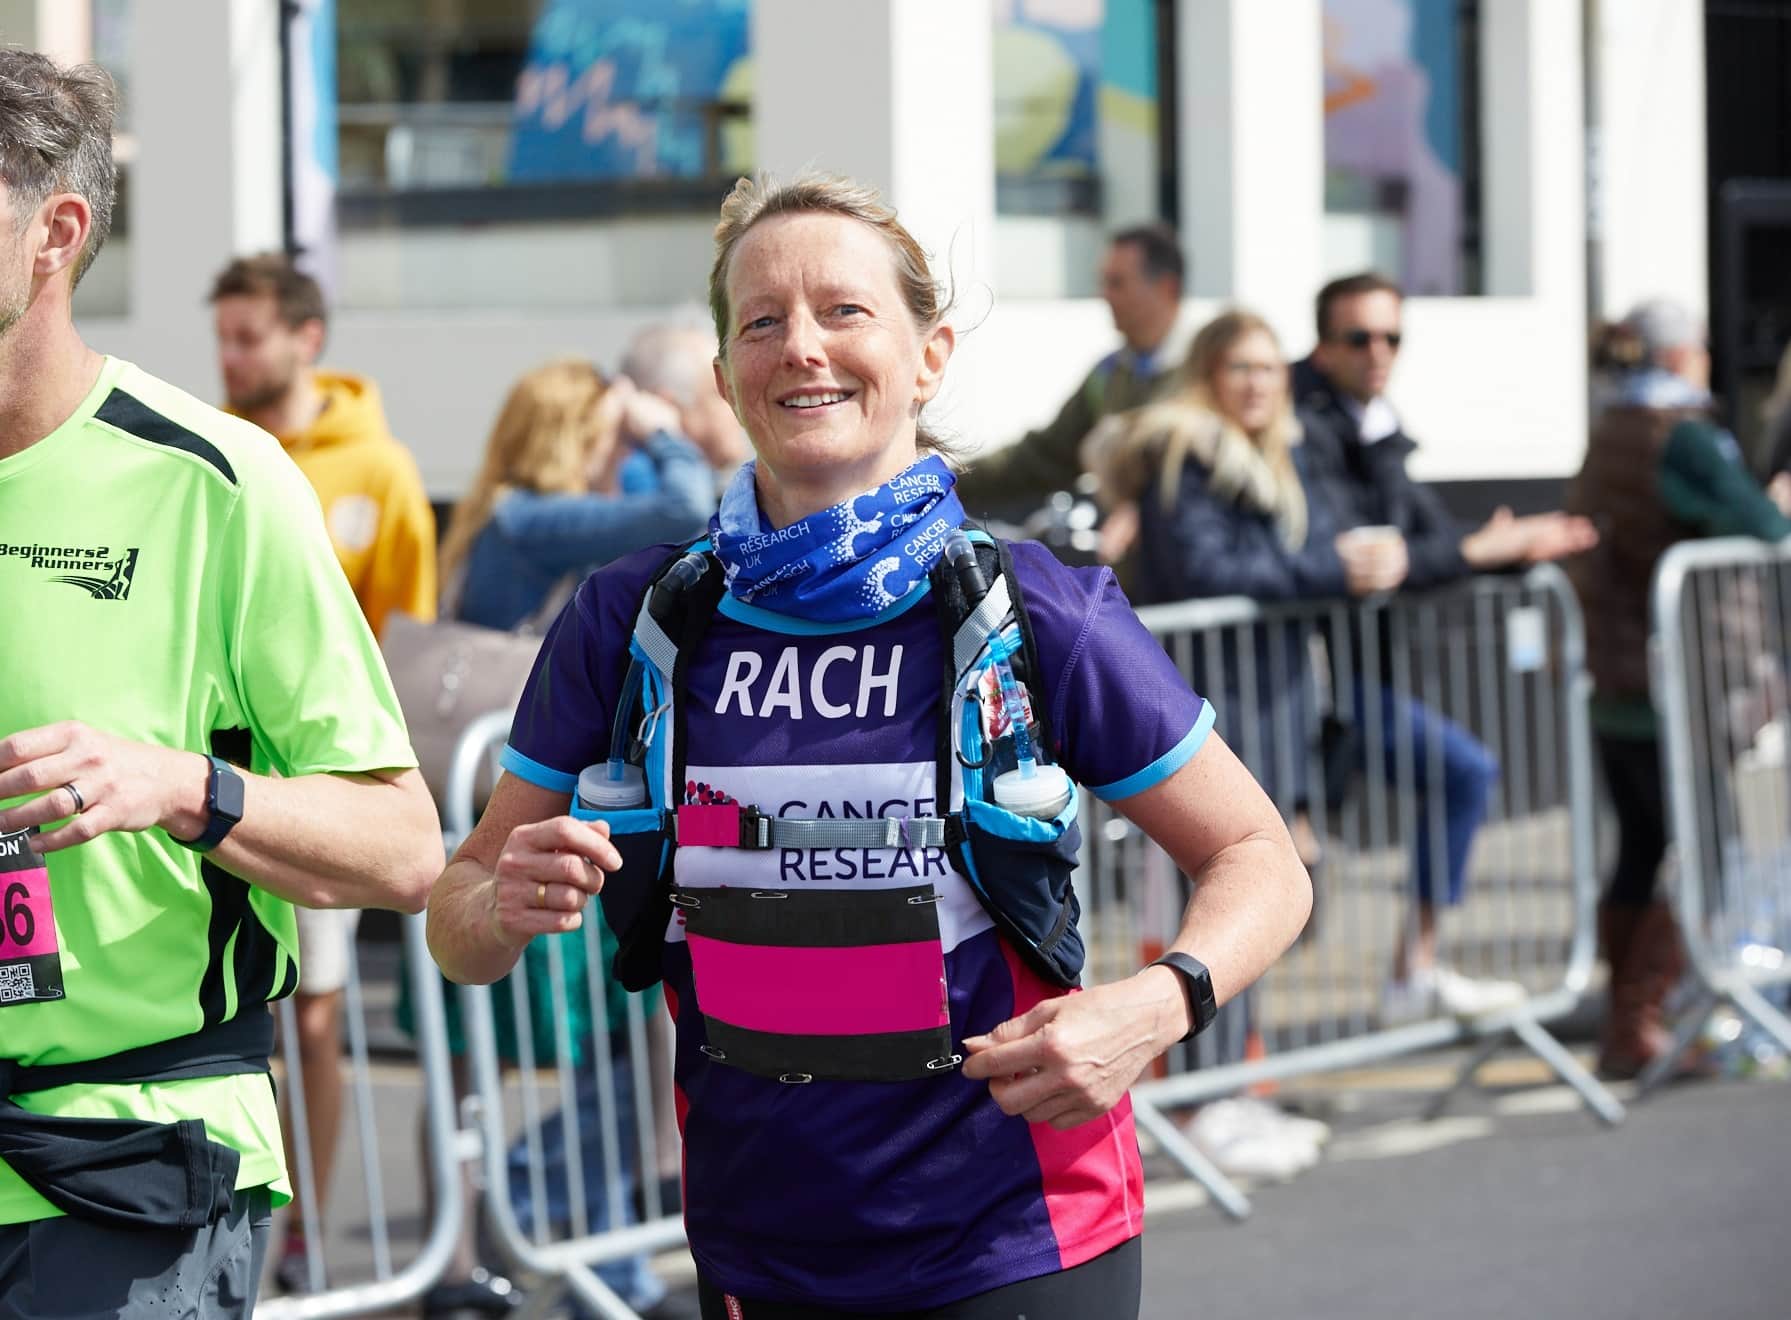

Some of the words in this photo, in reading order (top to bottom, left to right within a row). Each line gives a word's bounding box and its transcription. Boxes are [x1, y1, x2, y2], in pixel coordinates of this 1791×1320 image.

[888, 474, 941, 490] CANCER
[740, 521, 811, 555] RESEARCH
[904, 518, 950, 556] CANCER
[0, 543, 110, 559] Beginners2
[31, 556, 114, 571] Runners
[744, 553, 762, 569] UK
[715, 645, 904, 720] RACH
[0, 882, 35, 946] 6
